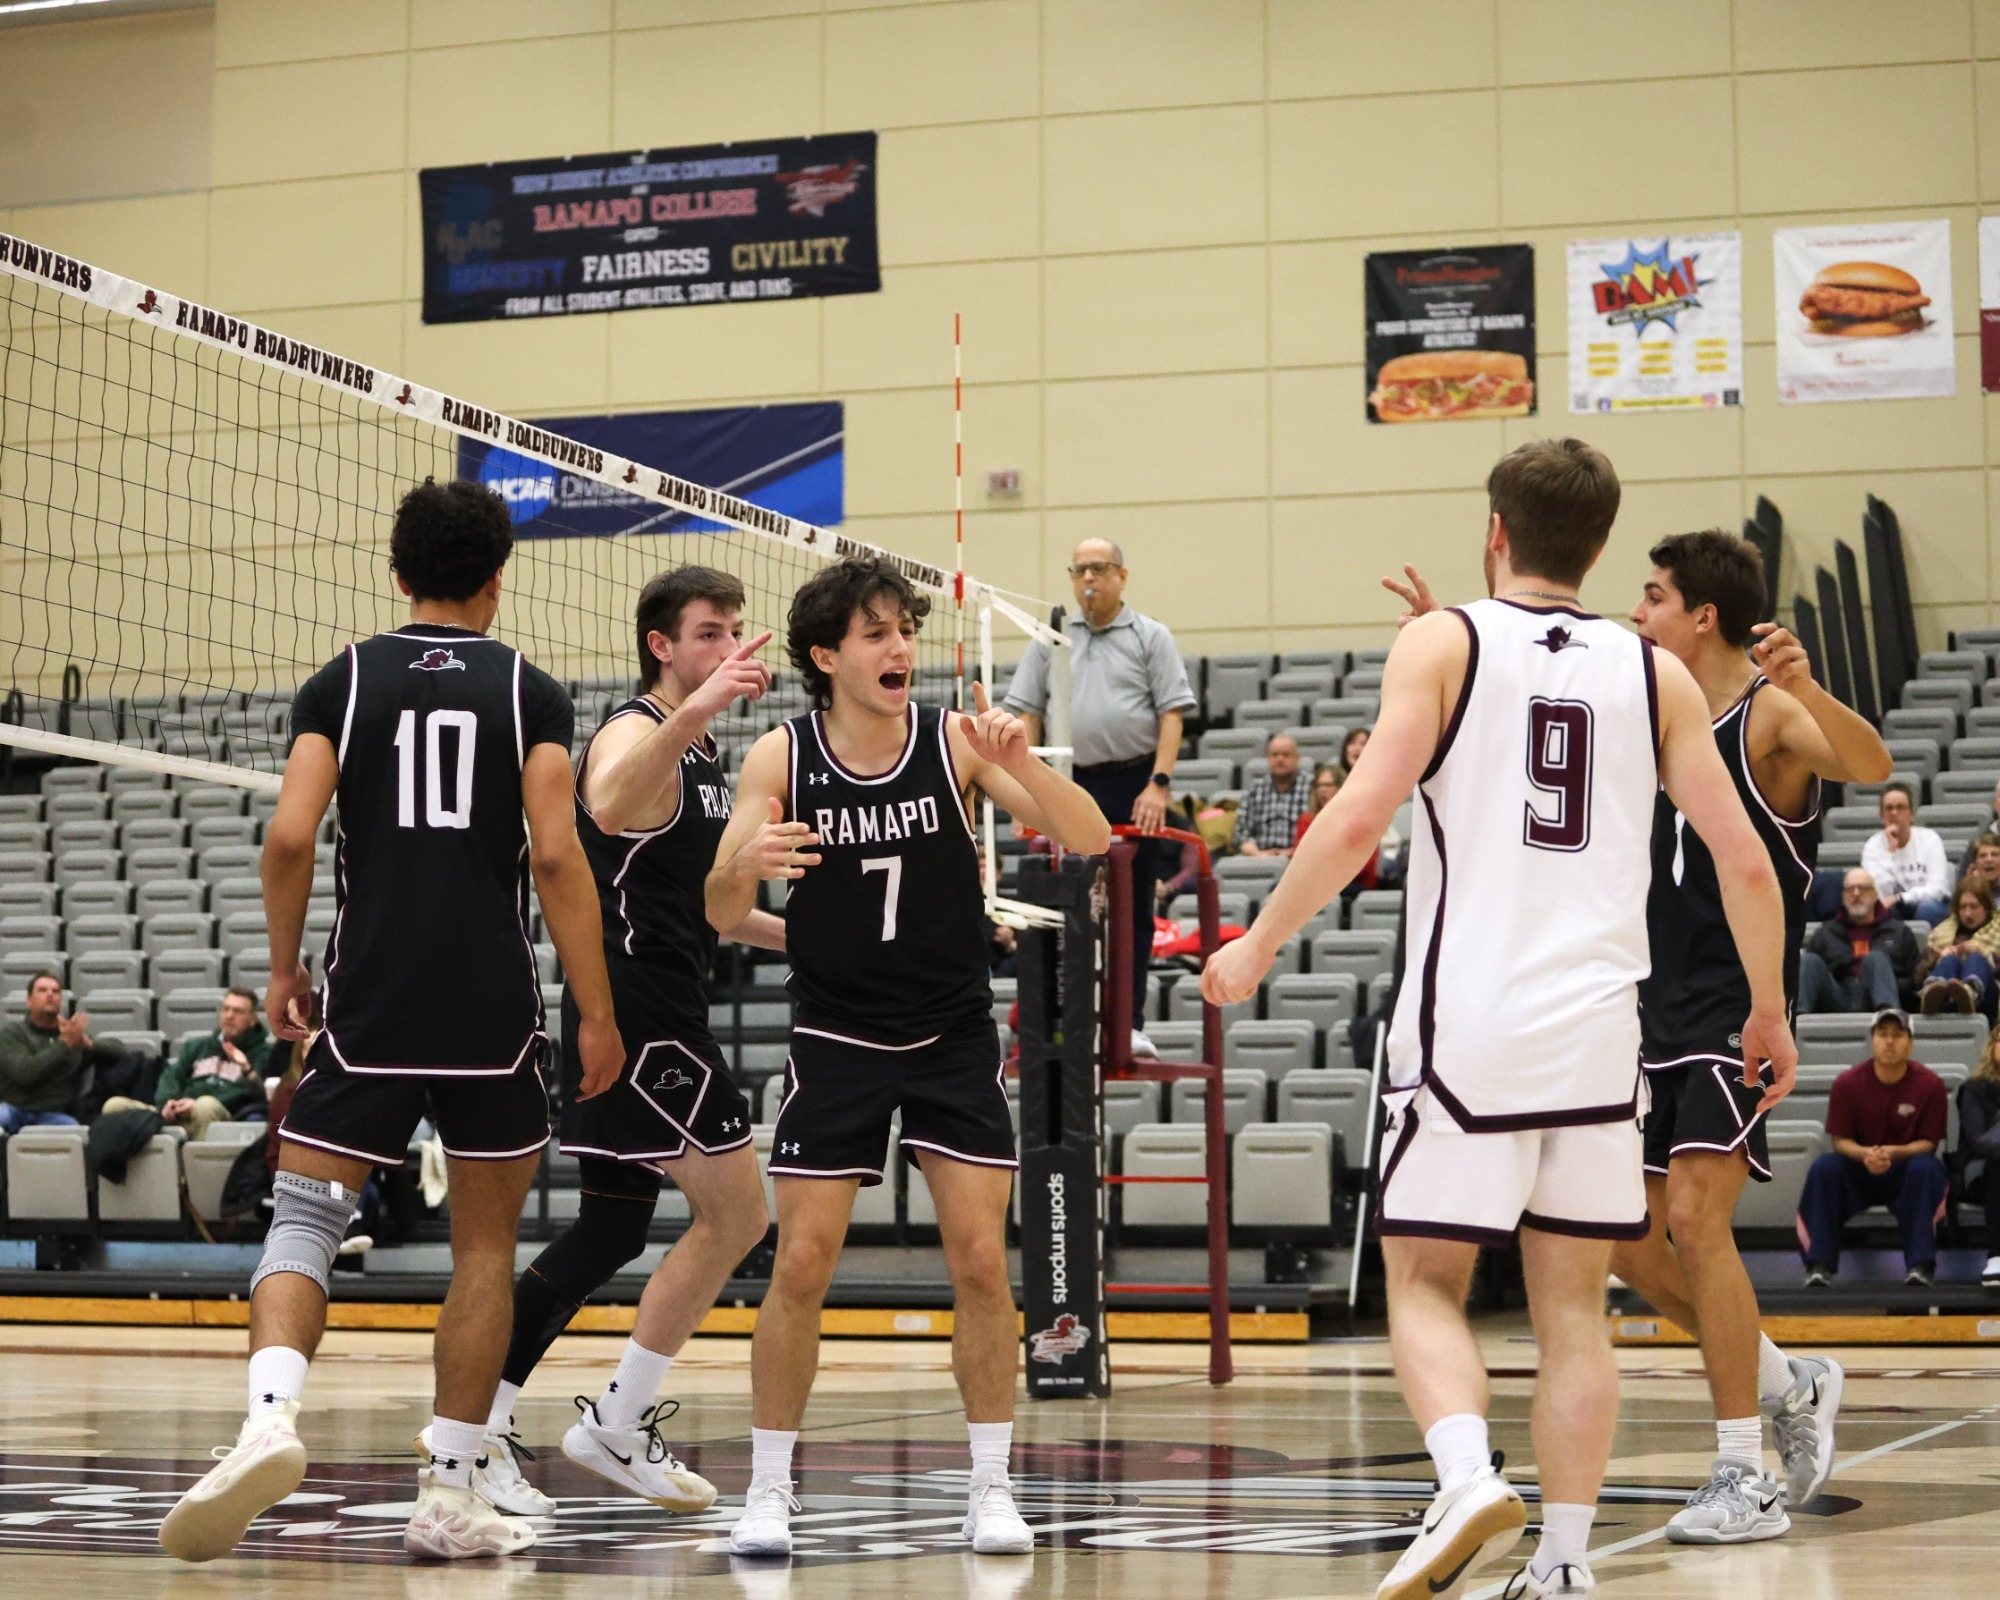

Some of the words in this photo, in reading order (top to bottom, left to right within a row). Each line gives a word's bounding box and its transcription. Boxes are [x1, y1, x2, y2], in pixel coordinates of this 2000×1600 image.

[533, 197, 643, 232] RAMAPO
[650, 188, 758, 222] COLLEGE
[582, 247, 710, 283] FAIRNESS
[731, 237, 850, 271] CIVILITY
[175, 299, 248, 350] RAMAPO
[253, 328, 375, 395] ROADRUNNERS
[441, 396, 501, 439] RAMAPO
[506, 420, 603, 474] ROADRUNNERS
[486, 475, 555, 502] NCAA
[657, 474, 707, 510] RAMAPO
[709, 492, 790, 537] ROADRUNNERS
[393, 709, 478, 829] 10
[1523, 695, 1594, 853] 9
[815, 795, 939, 846] RAMAPO
[861, 855, 902, 942] 7
[1048, 1172, 1067, 1231] sports
[1048, 1233, 1067, 1304] imports
